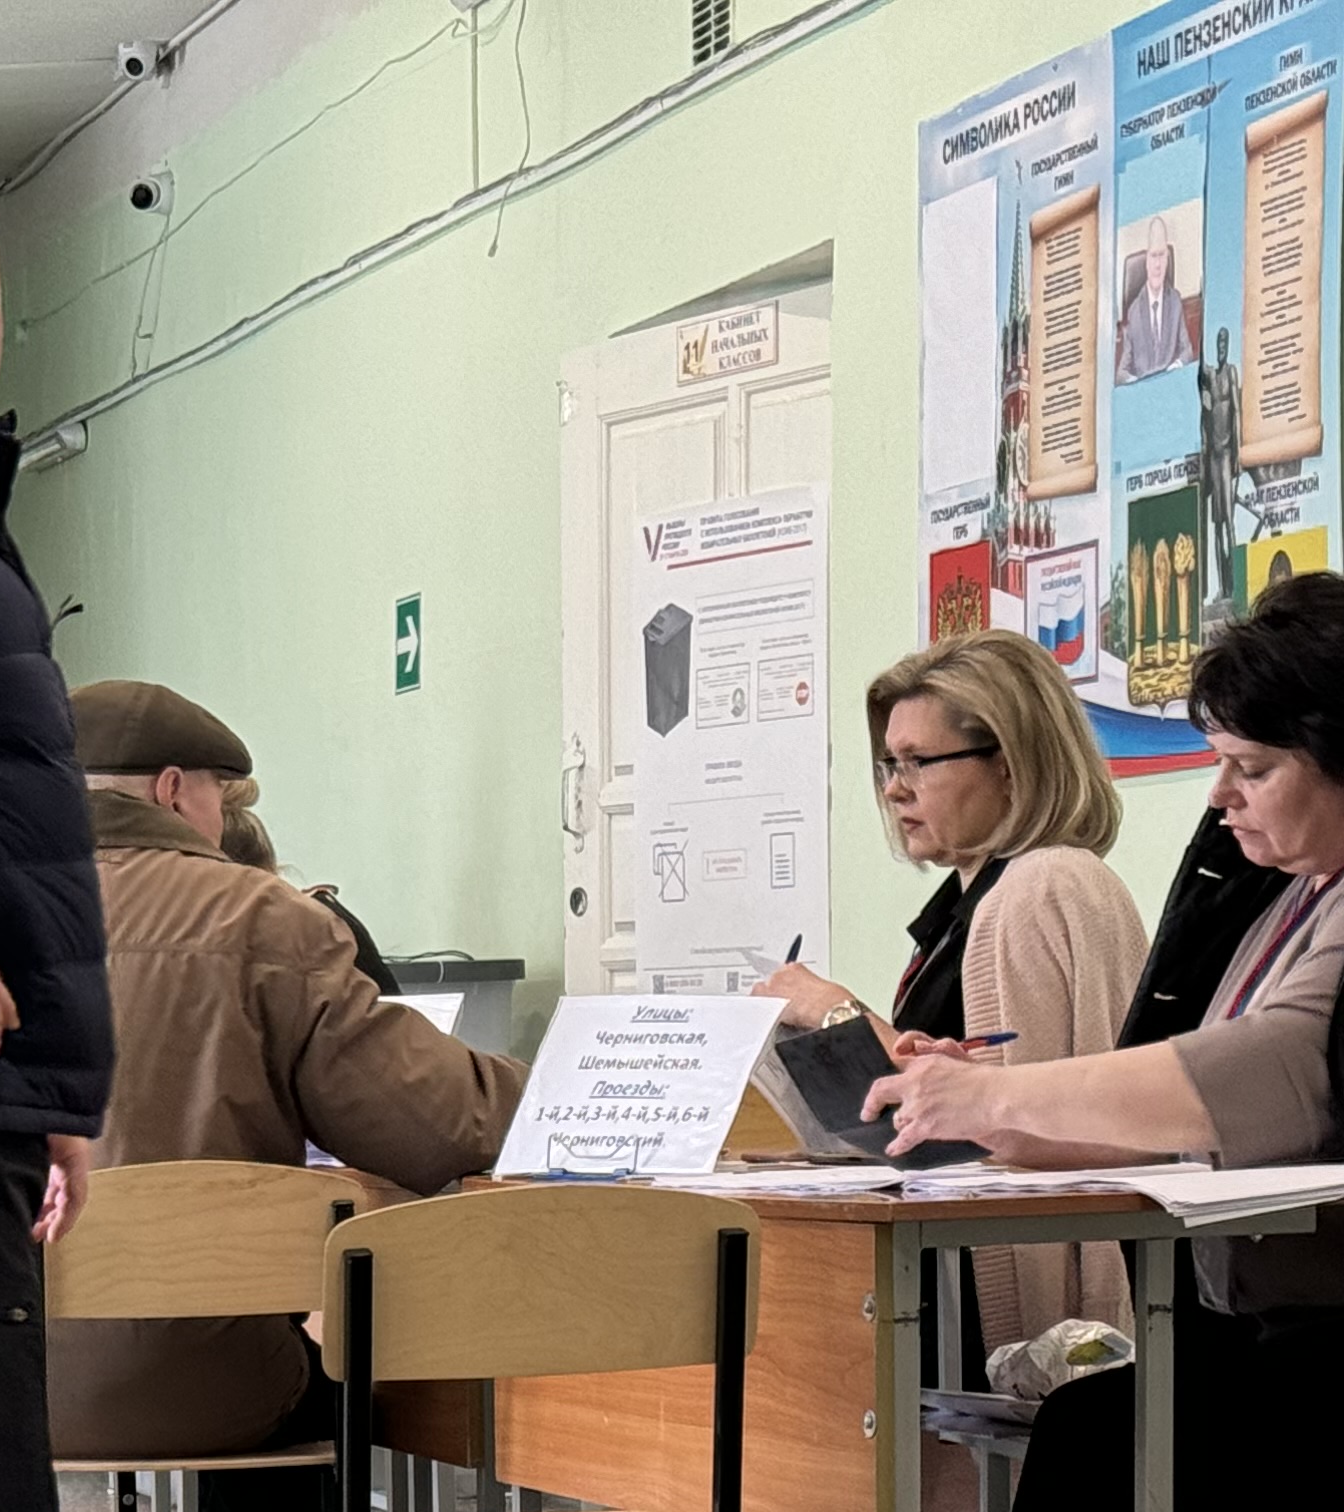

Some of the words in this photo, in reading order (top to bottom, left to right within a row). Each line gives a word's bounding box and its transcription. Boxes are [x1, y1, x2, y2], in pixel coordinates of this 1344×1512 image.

[1137, 37, 1171, 79] НАШ
[943, 112, 1020, 165] СИМВОЛИКА
[1023, 81, 1076, 132] РОССИИ
[684, 340, 699, 364] 11
[632, 1005, 694, 1022] Улицы:
[596, 1030, 708, 1049] Черниговская,
[591, 1080, 669, 1097] Проезды:
